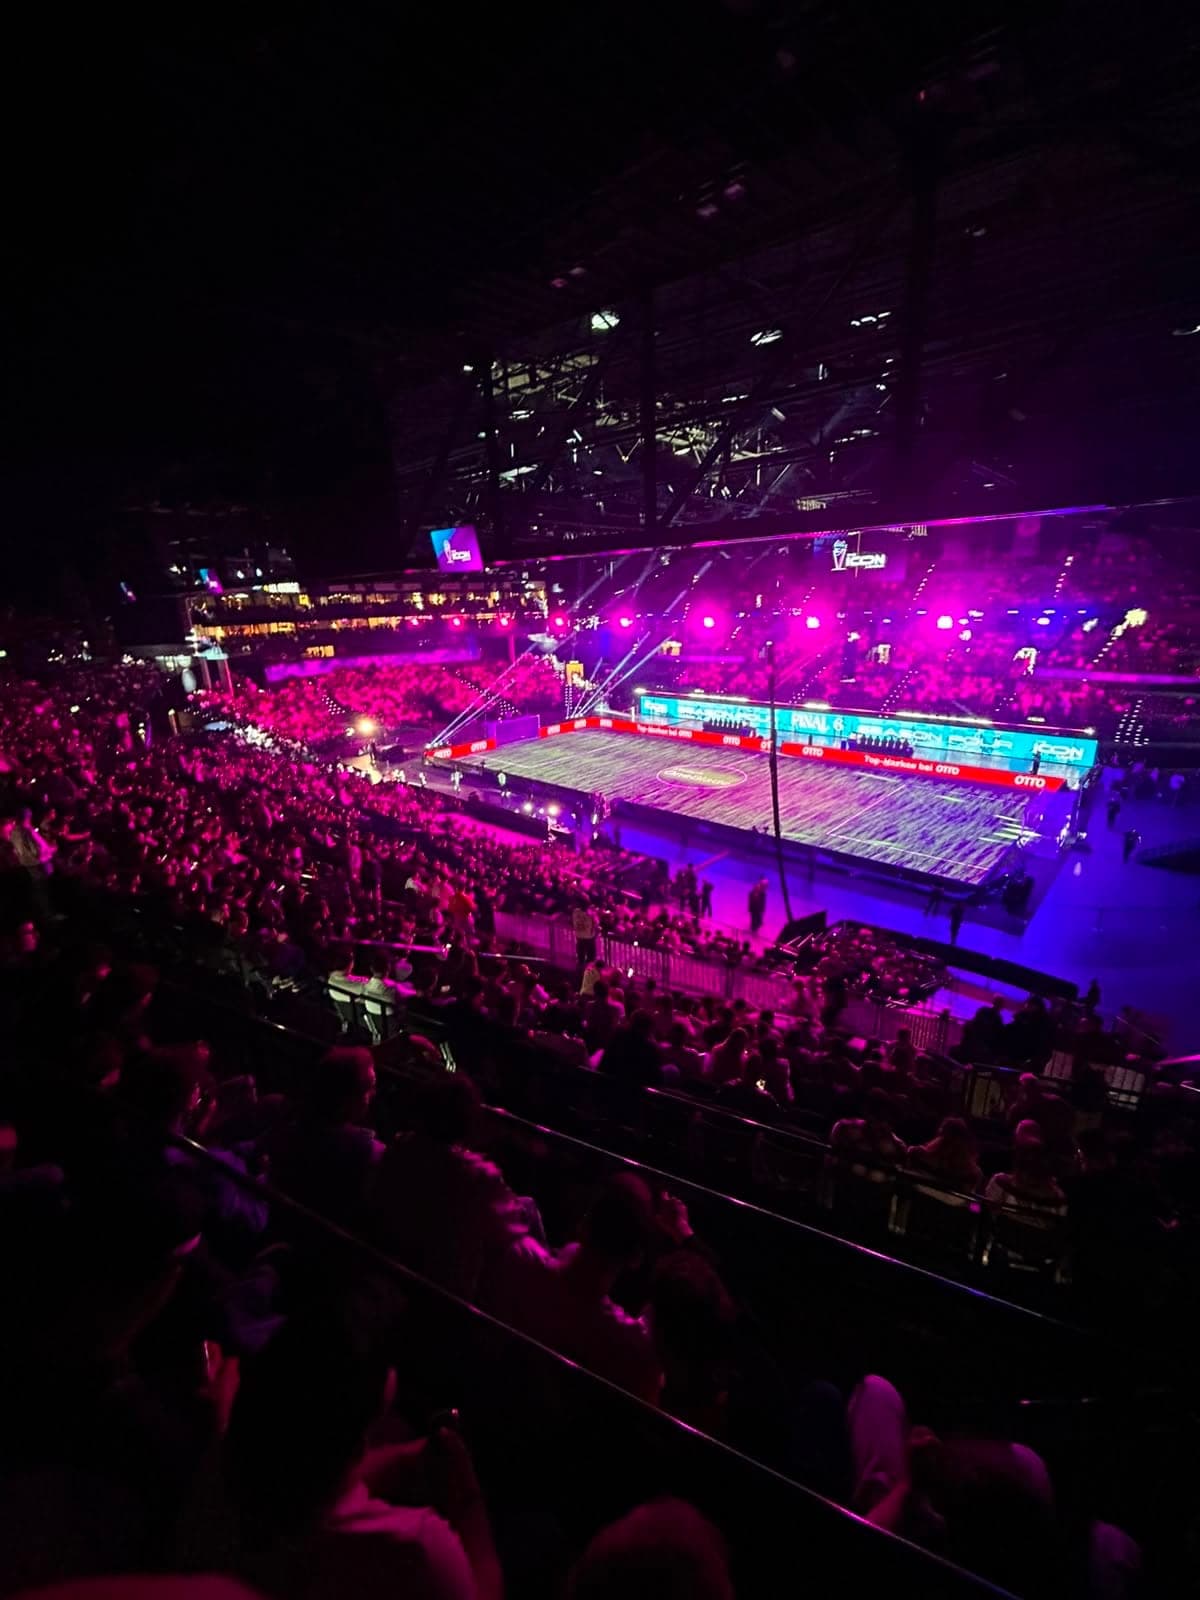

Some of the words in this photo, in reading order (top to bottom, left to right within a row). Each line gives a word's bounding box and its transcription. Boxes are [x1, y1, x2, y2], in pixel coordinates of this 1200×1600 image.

[833, 718, 844, 731] 6
[722, 735, 741, 746] OTTO
[802, 746, 824, 757] OTTO
[935, 765, 960, 775] OTTO
[1014, 775, 1046, 788] OTTO
